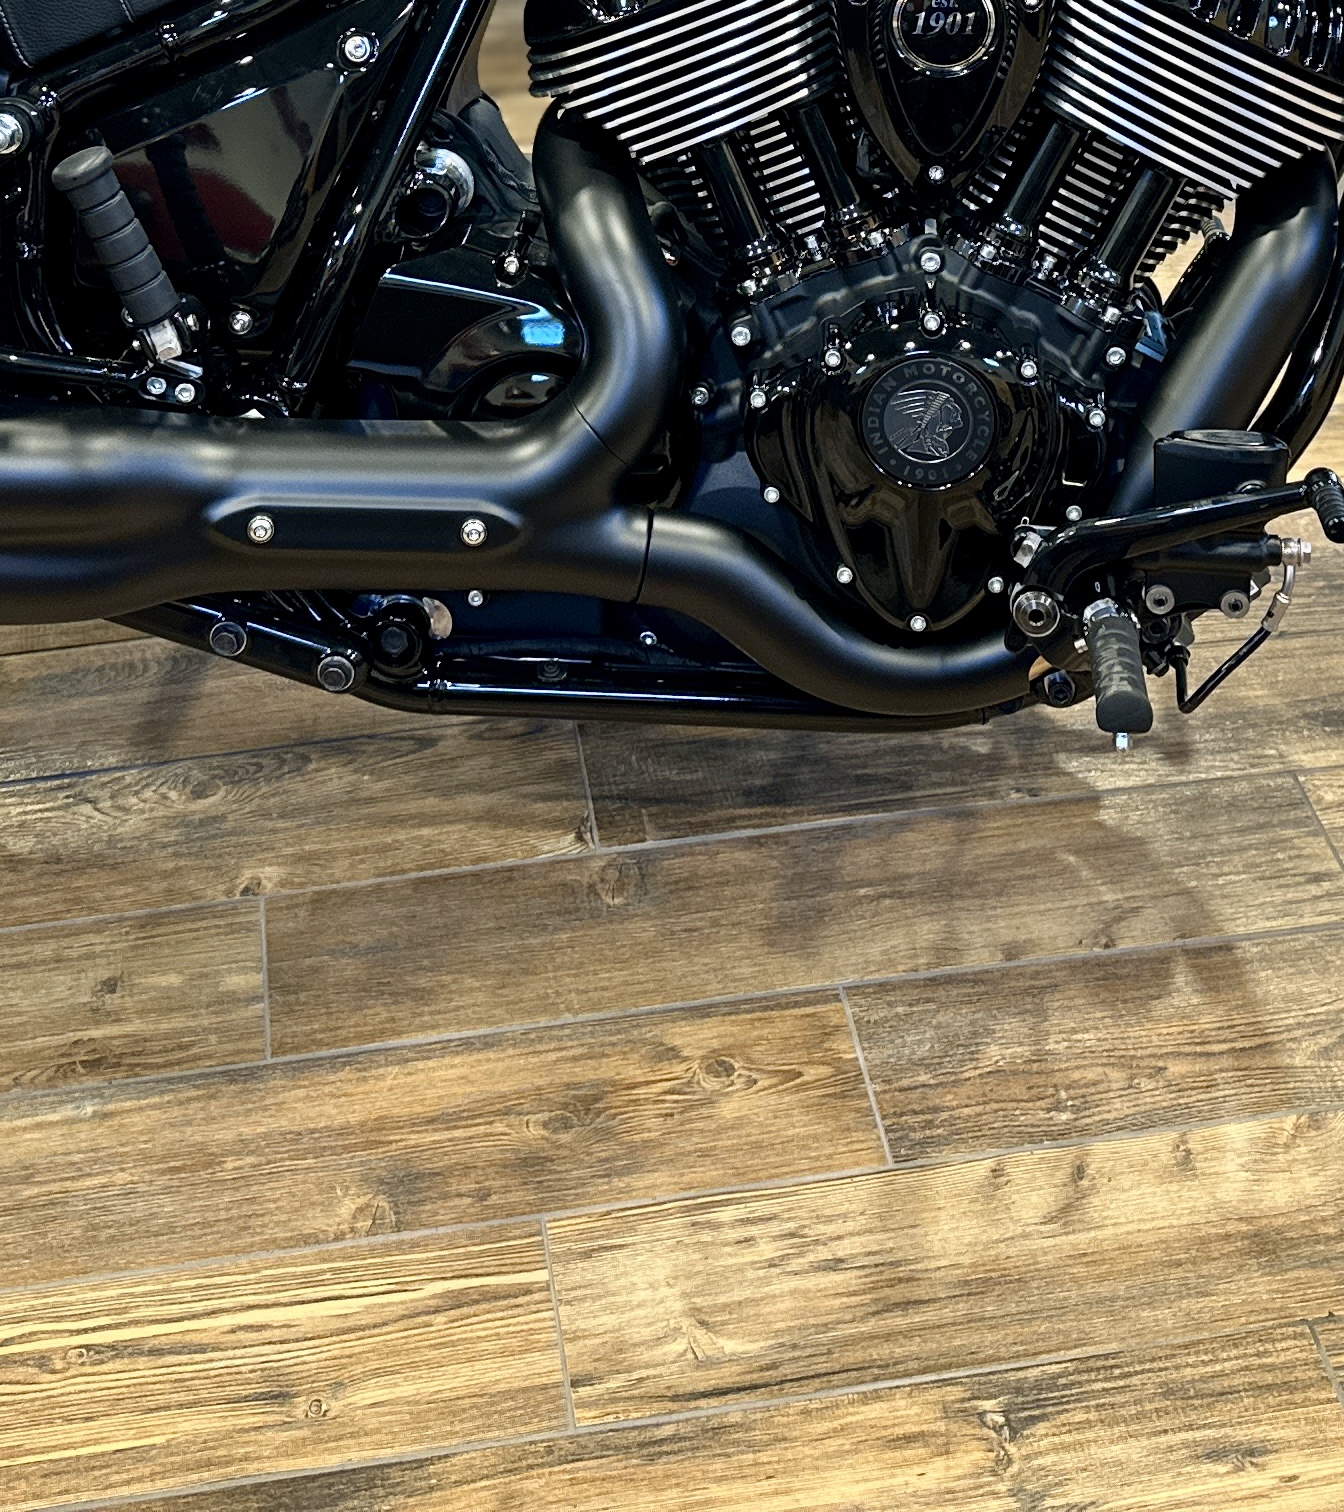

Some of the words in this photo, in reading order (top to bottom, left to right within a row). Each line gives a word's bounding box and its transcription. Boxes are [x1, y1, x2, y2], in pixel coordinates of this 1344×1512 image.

[911, 11, 976, 36] 1901
[867, 376, 897, 455] INDIAN
[903, 363, 990, 462] MOTORCYCLE
